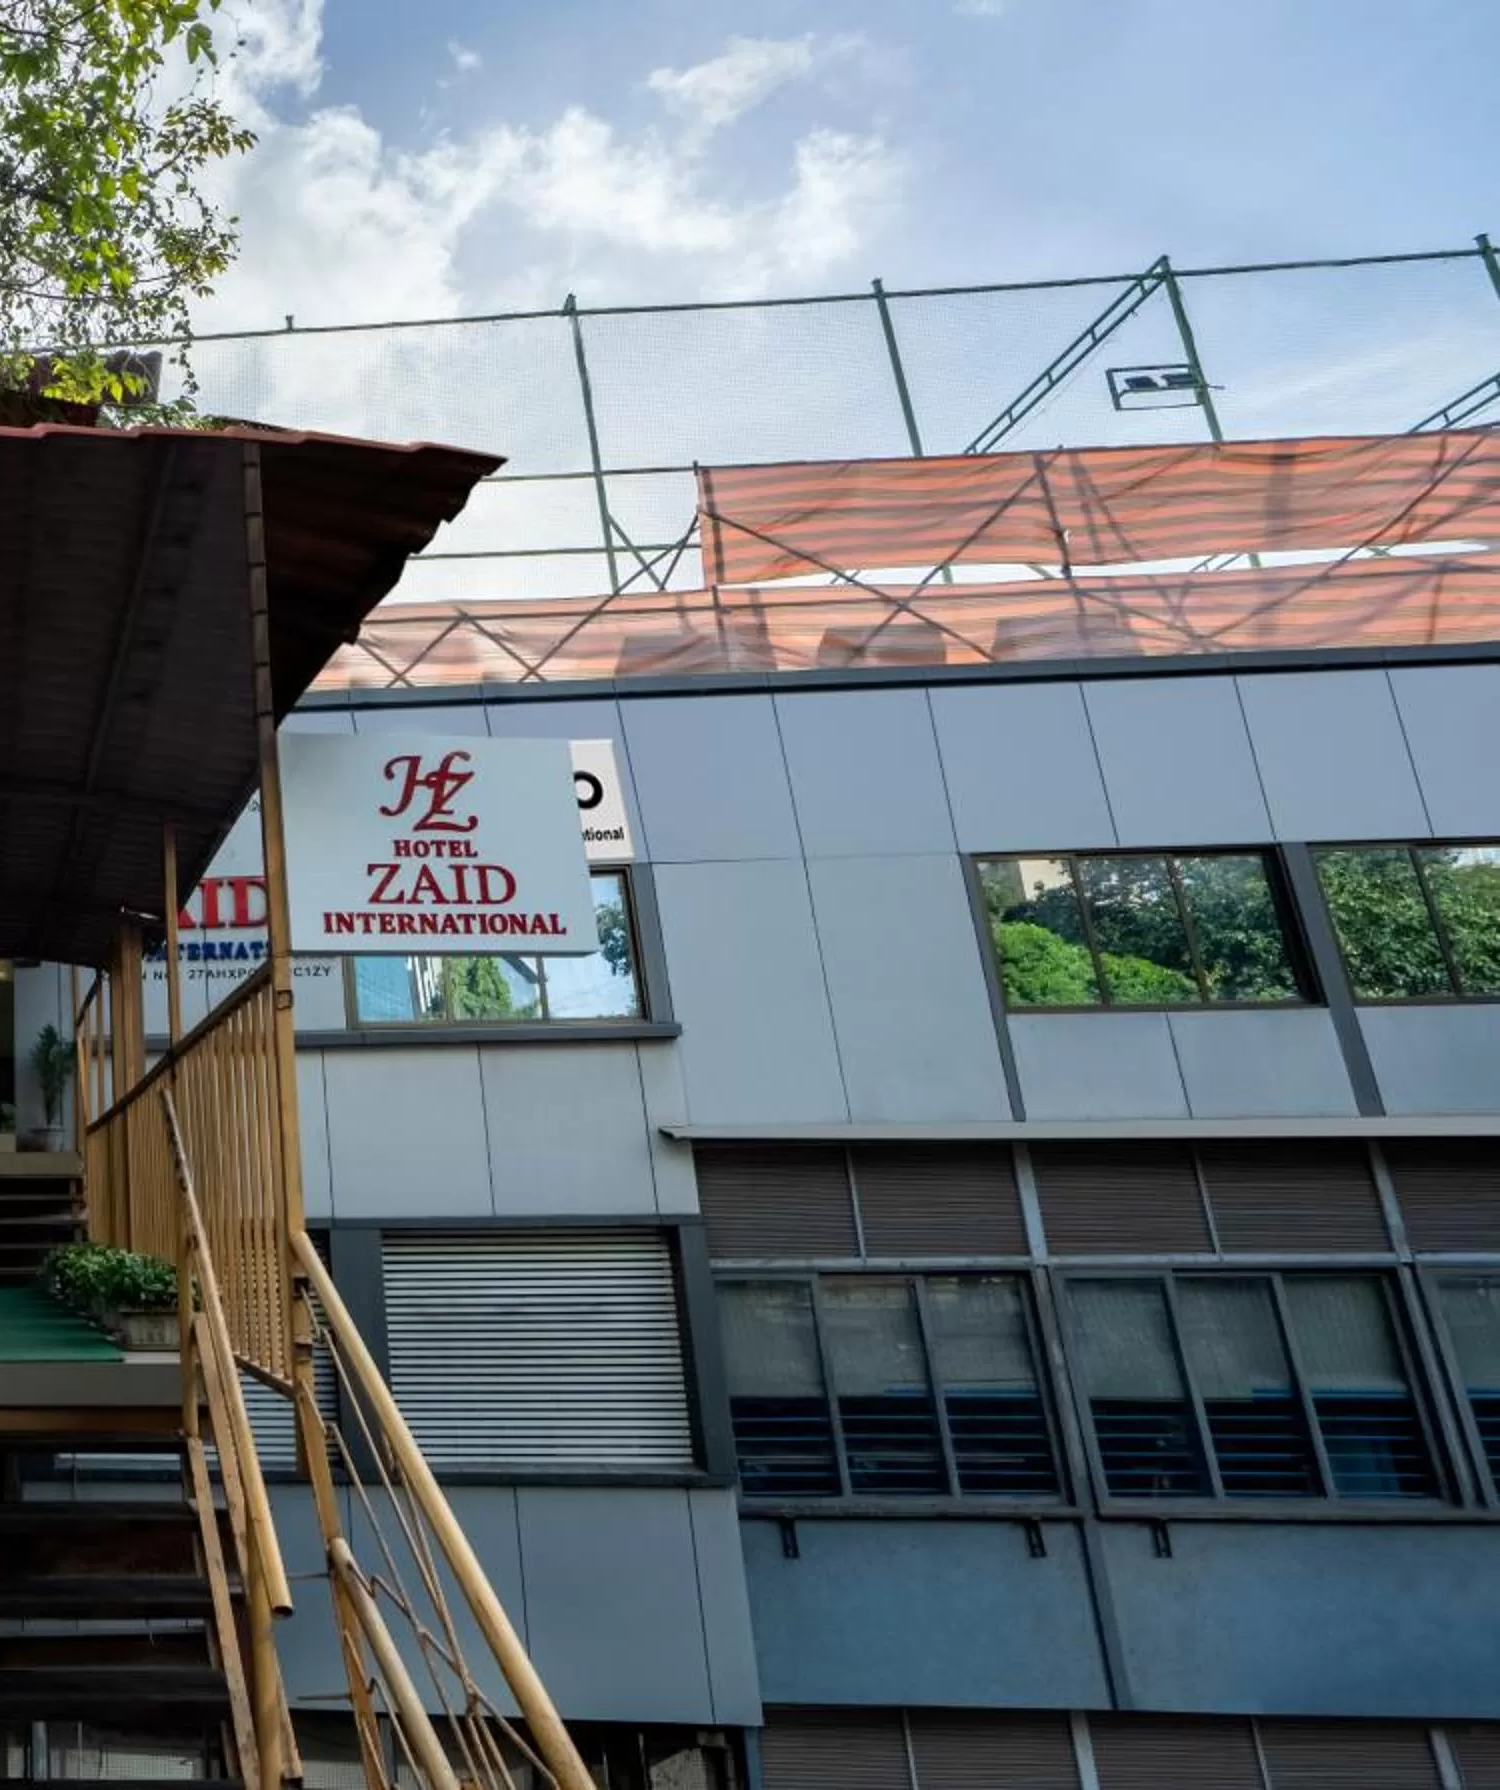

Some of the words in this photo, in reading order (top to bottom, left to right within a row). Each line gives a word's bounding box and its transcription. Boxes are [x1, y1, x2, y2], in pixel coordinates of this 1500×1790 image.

[393, 839, 479, 859] HOTEL
[366, 862, 517, 906] ZAID
[323, 911, 567, 936] INTERNATIONAL
